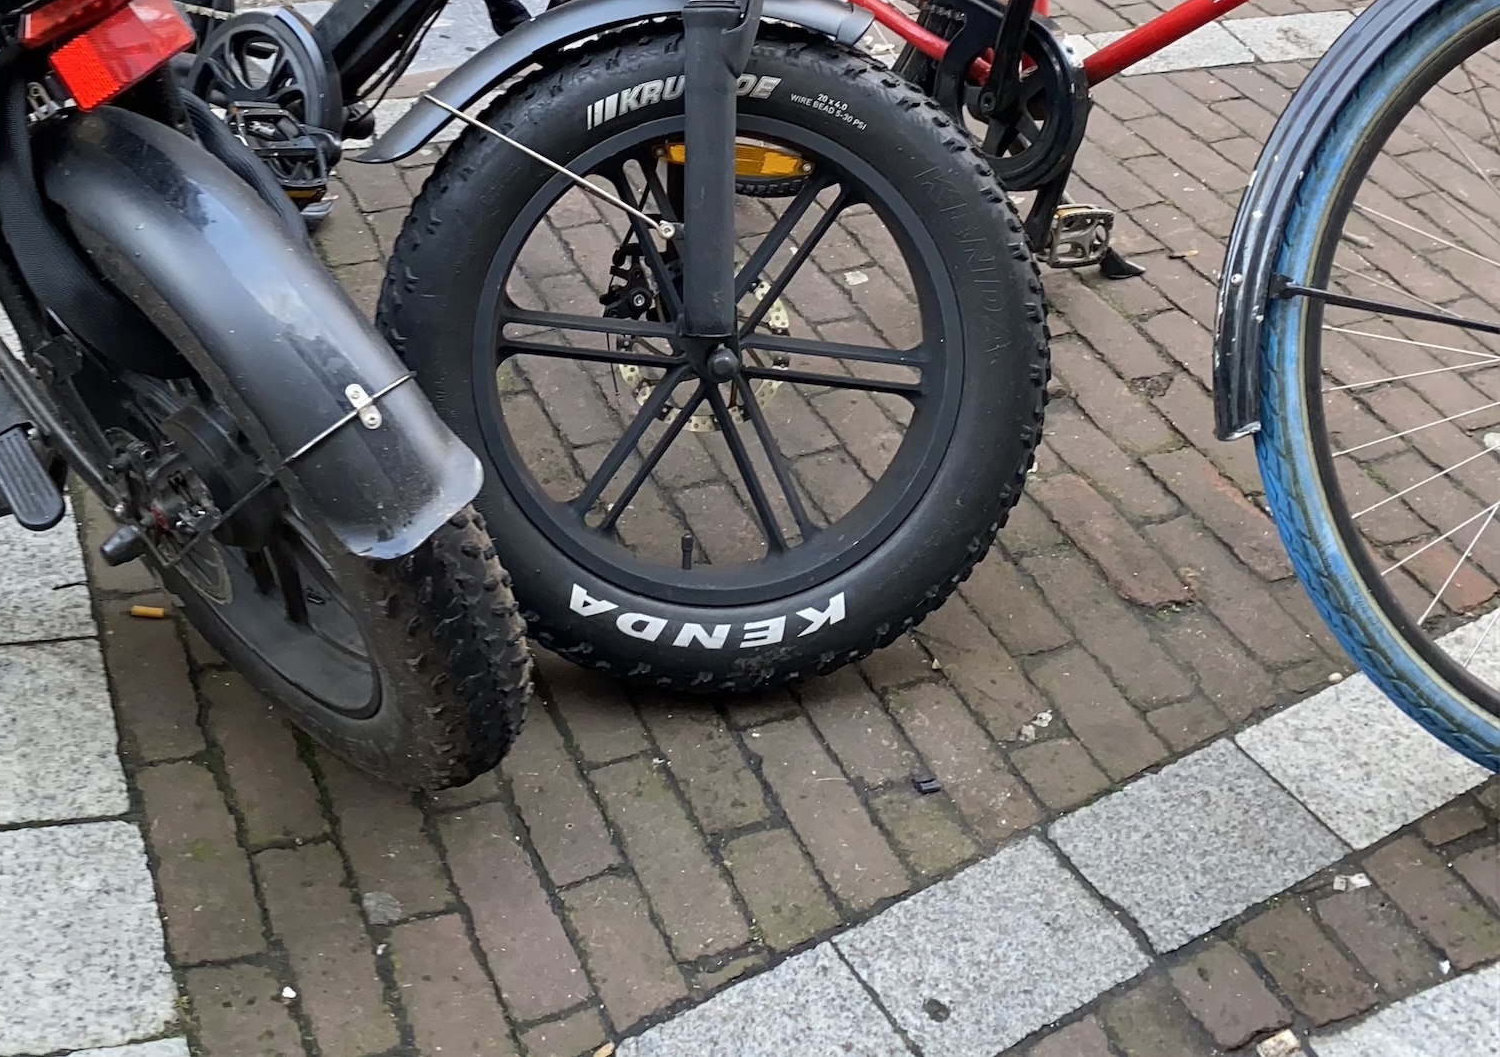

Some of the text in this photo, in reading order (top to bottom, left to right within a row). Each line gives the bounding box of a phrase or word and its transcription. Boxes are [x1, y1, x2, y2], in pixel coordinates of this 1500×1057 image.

[618, 73, 783, 116] KRUDE
[790, 93, 868, 131] WIRE BEAD 5-30 PSI
[817, 93, 829, 103] 20
[835, 100, 848, 111] 4.0
[569, 582, 846, 649] KENDA
